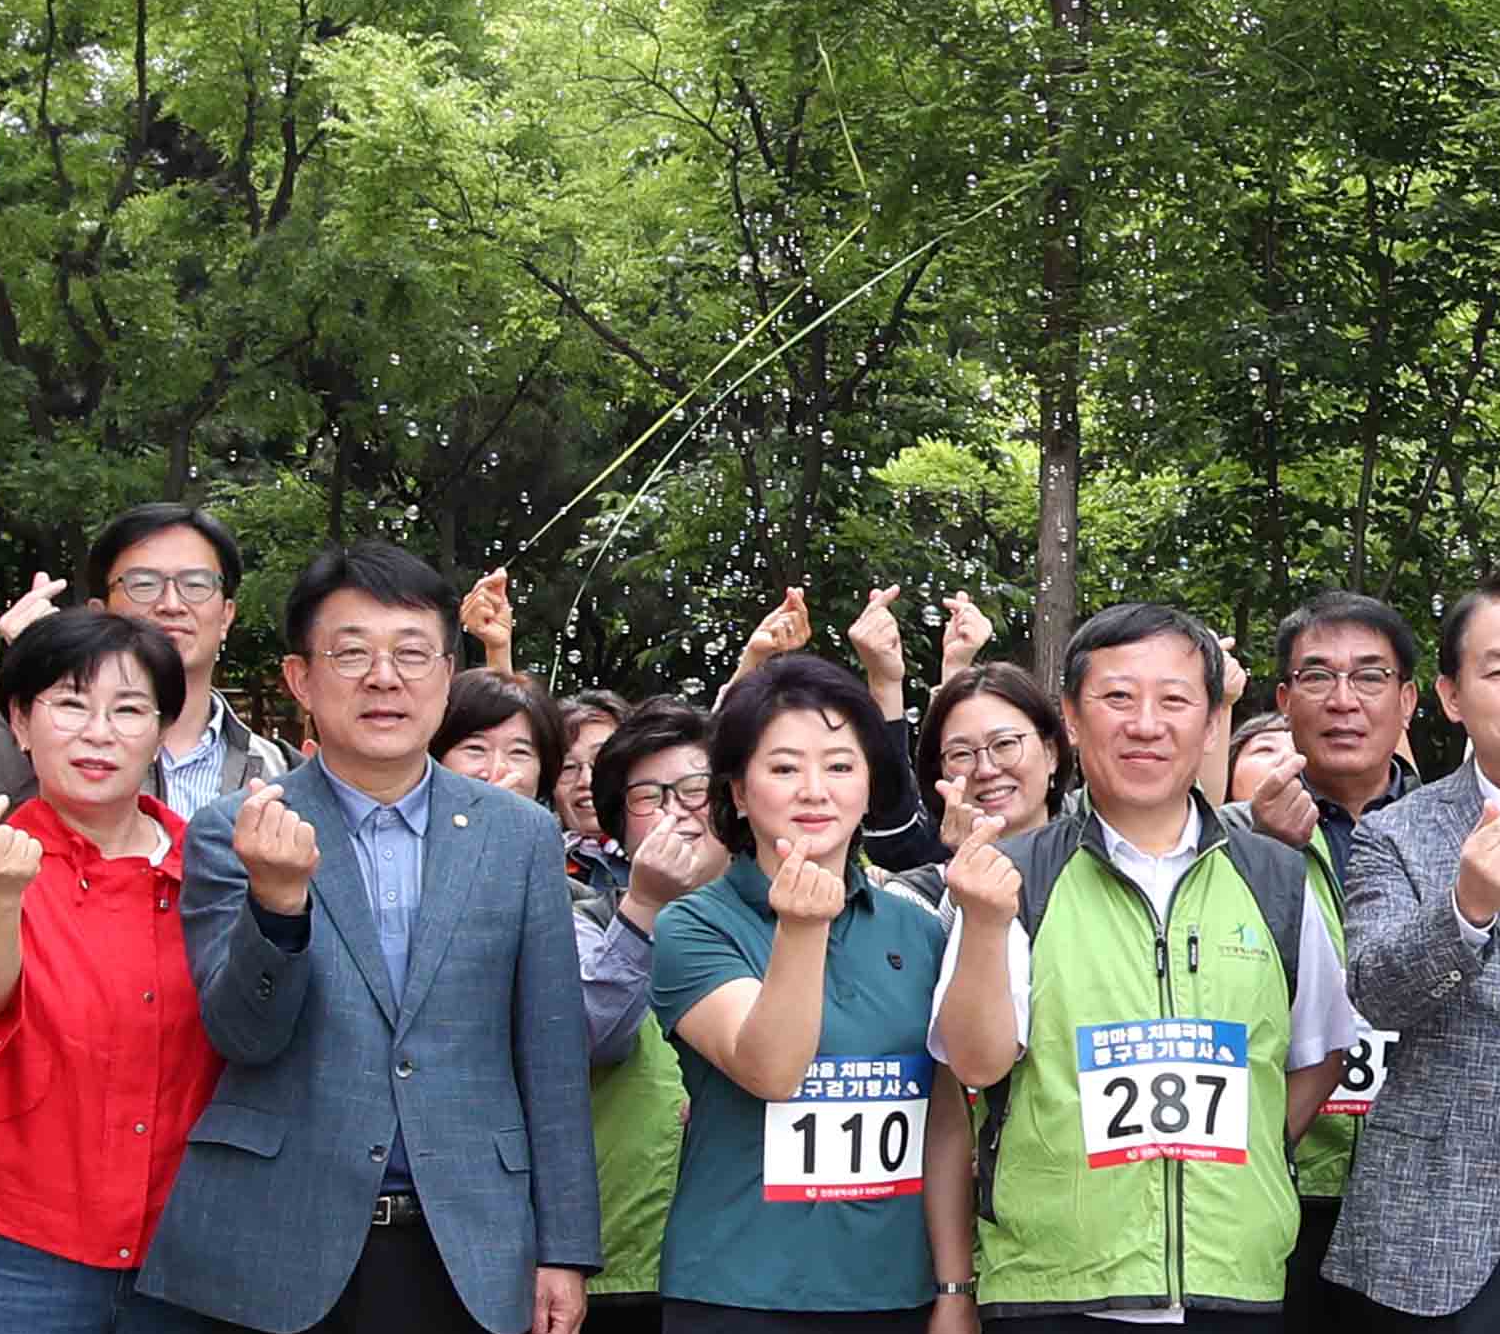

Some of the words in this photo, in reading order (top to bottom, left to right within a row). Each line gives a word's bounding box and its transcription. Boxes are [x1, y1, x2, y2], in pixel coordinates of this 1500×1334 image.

[1342, 1037, 1387, 1092] 8
[1103, 1072, 1227, 1139] 287
[791, 1110, 909, 1174] 110
